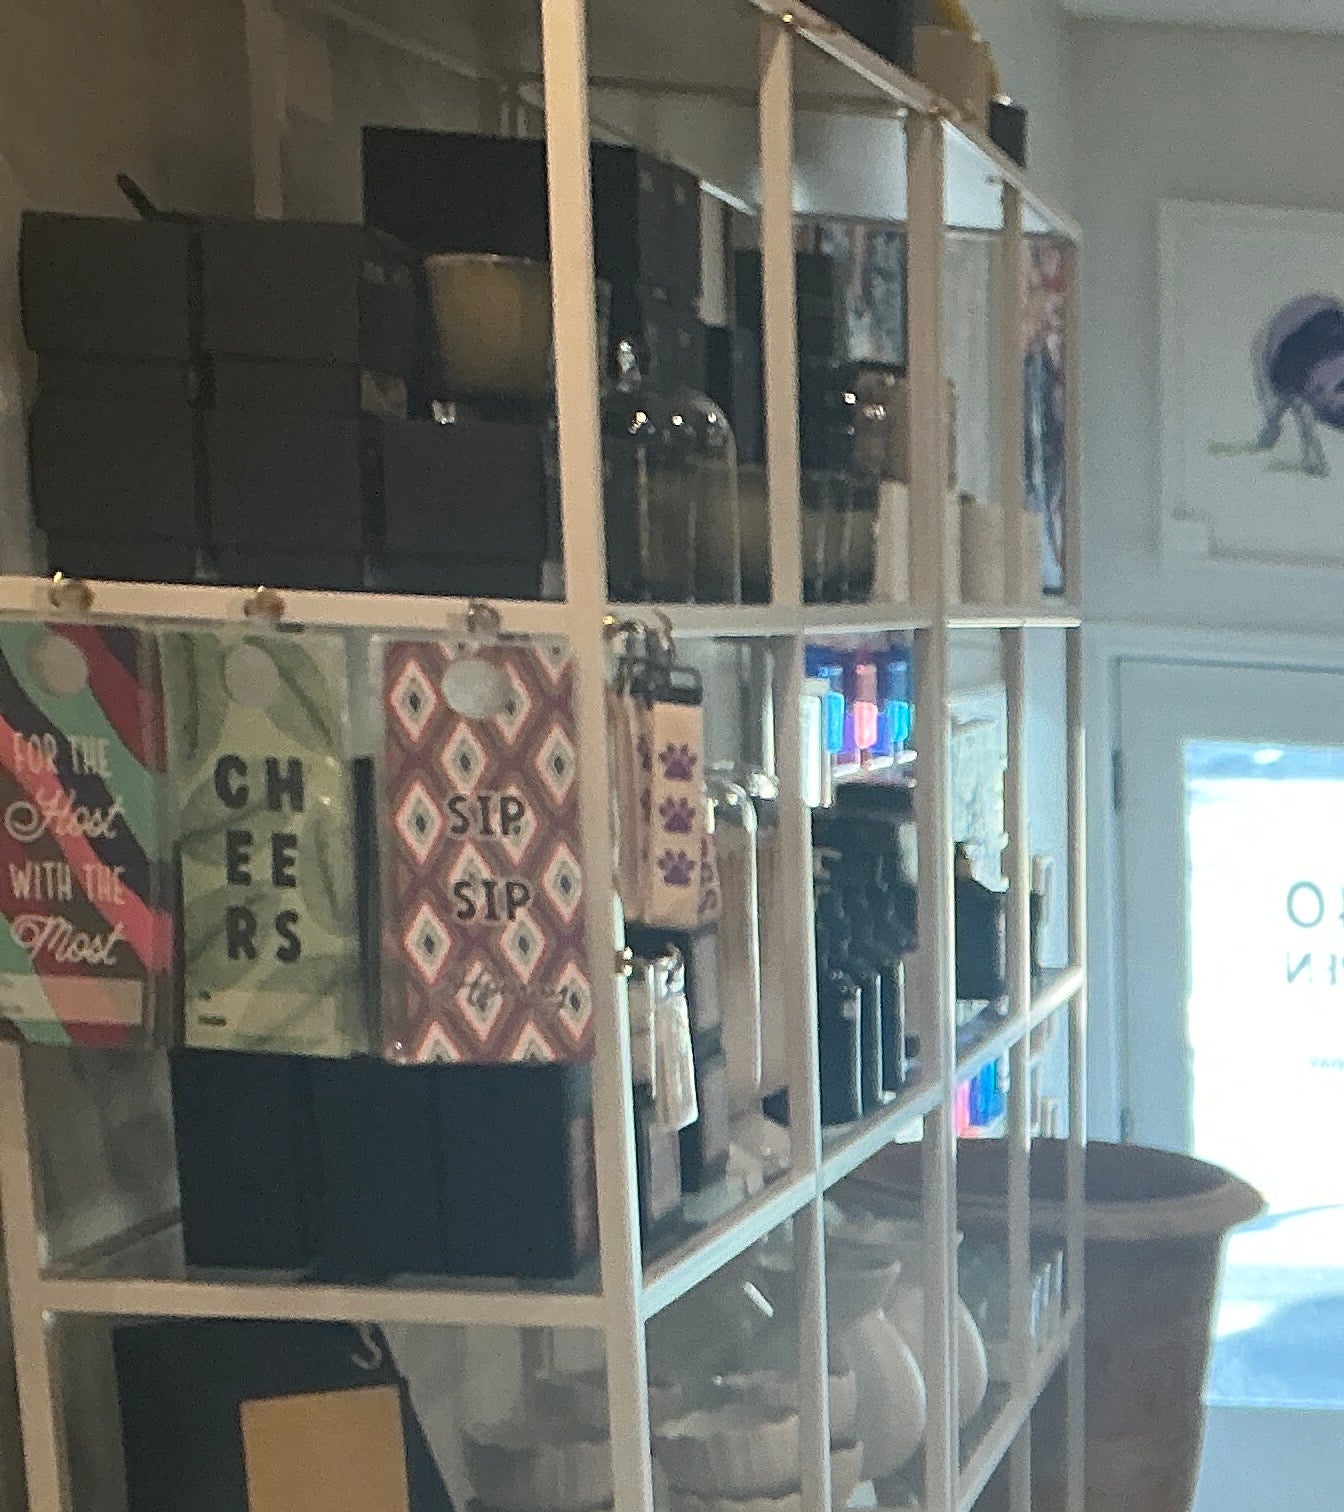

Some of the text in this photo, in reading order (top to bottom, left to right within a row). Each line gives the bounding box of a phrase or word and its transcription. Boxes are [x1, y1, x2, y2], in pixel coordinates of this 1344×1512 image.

[13, 733, 110, 777] FOR THE
[4, 788, 124, 842] Host
[449, 796, 525, 835] SIP
[9, 862, 125, 905] WITH THE
[453, 880, 531, 921] SIP
[11, 912, 125, 966] Most
